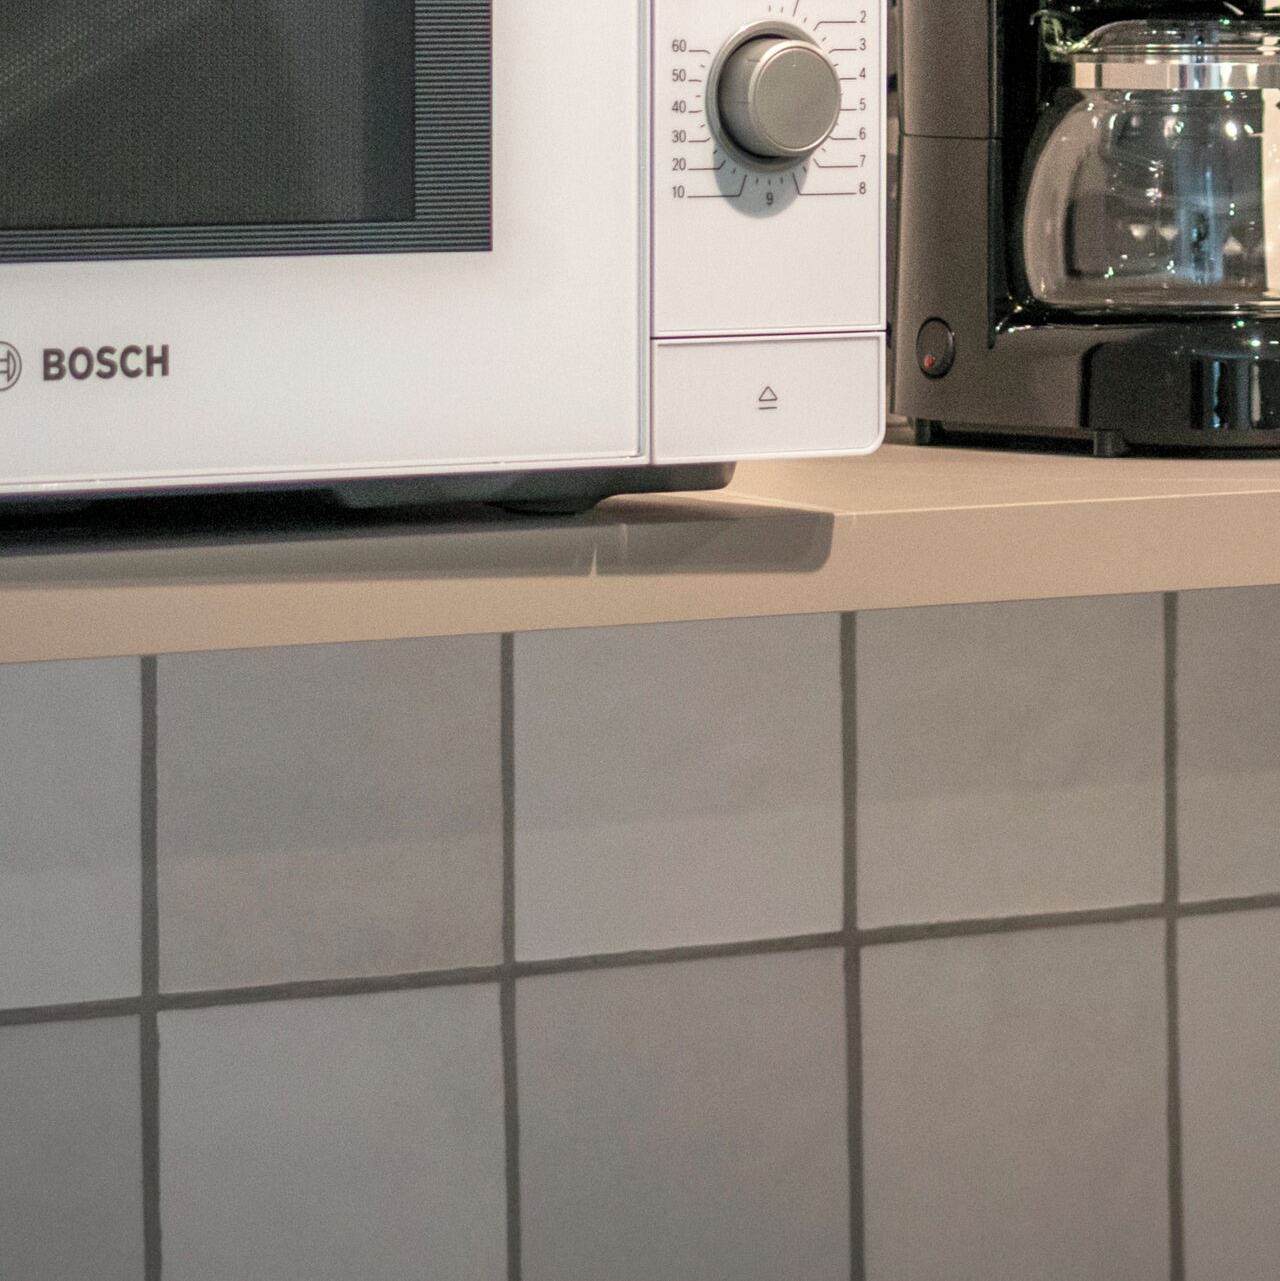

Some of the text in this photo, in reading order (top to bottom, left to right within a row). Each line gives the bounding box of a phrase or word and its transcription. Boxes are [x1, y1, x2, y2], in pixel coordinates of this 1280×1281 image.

[859, 9, 867, 24] 2
[671, 38, 688, 53] 60
[859, 37, 867, 52] 3
[671, 68, 687, 83] 50
[858, 67, 867, 80] 4
[671, 99, 687, 114] 40
[859, 97, 867, 112] 5
[671, 129, 687, 144] 30
[858, 126, 867, 141] 6
[671, 156, 687, 172] 20
[859, 153, 867, 167] 7
[672, 185, 686, 198] 10
[858, 181, 867, 196] 8
[765, 191, 774, 207] 9
[43, 344, 170, 382] BOSCH
